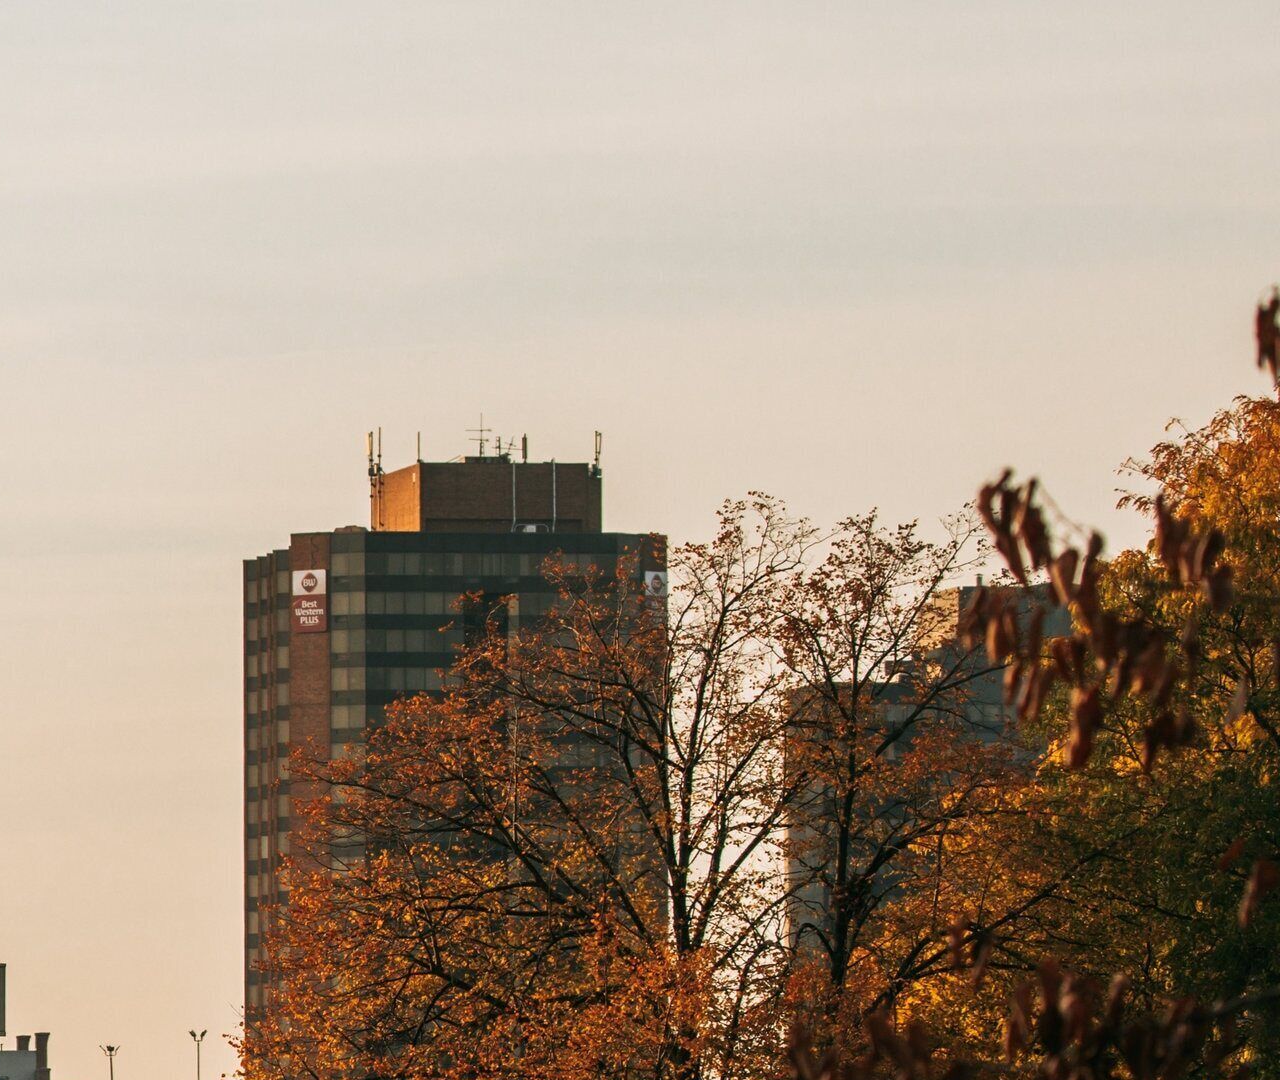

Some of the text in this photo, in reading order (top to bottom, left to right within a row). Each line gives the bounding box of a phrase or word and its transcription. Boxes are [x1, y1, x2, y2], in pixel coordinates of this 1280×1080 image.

[303, 578, 316, 587] BW
[301, 600, 318, 608] Best
[295, 608, 324, 616] Western
[300, 616, 319, 624] PLUS
